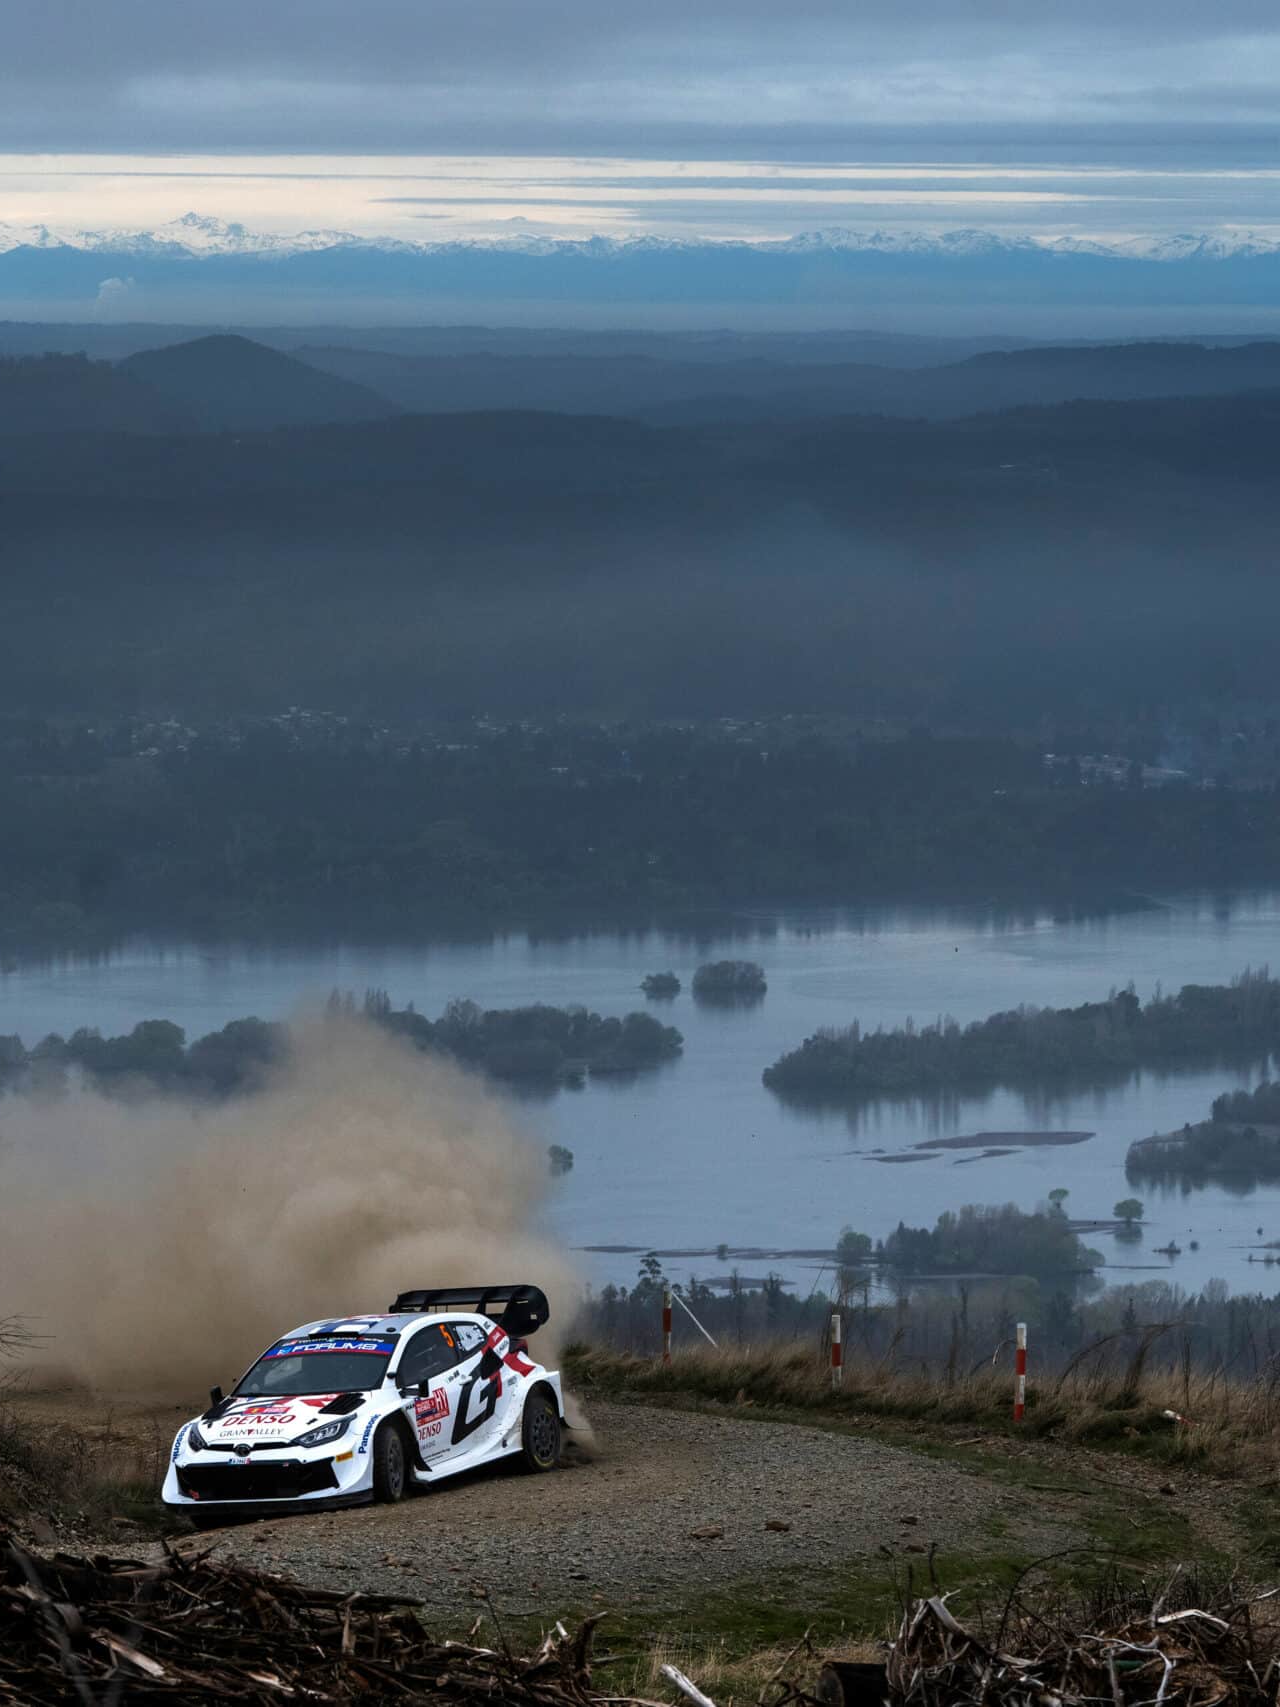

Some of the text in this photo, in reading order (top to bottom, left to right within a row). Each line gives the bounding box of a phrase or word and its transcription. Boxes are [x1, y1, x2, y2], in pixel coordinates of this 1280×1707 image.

[439, 1324, 455, 1348] 5
[291, 1342, 378, 1353] FORUM8
[433, 1388, 448, 1411] HY
[222, 1414, 297, 1427] DENSO
